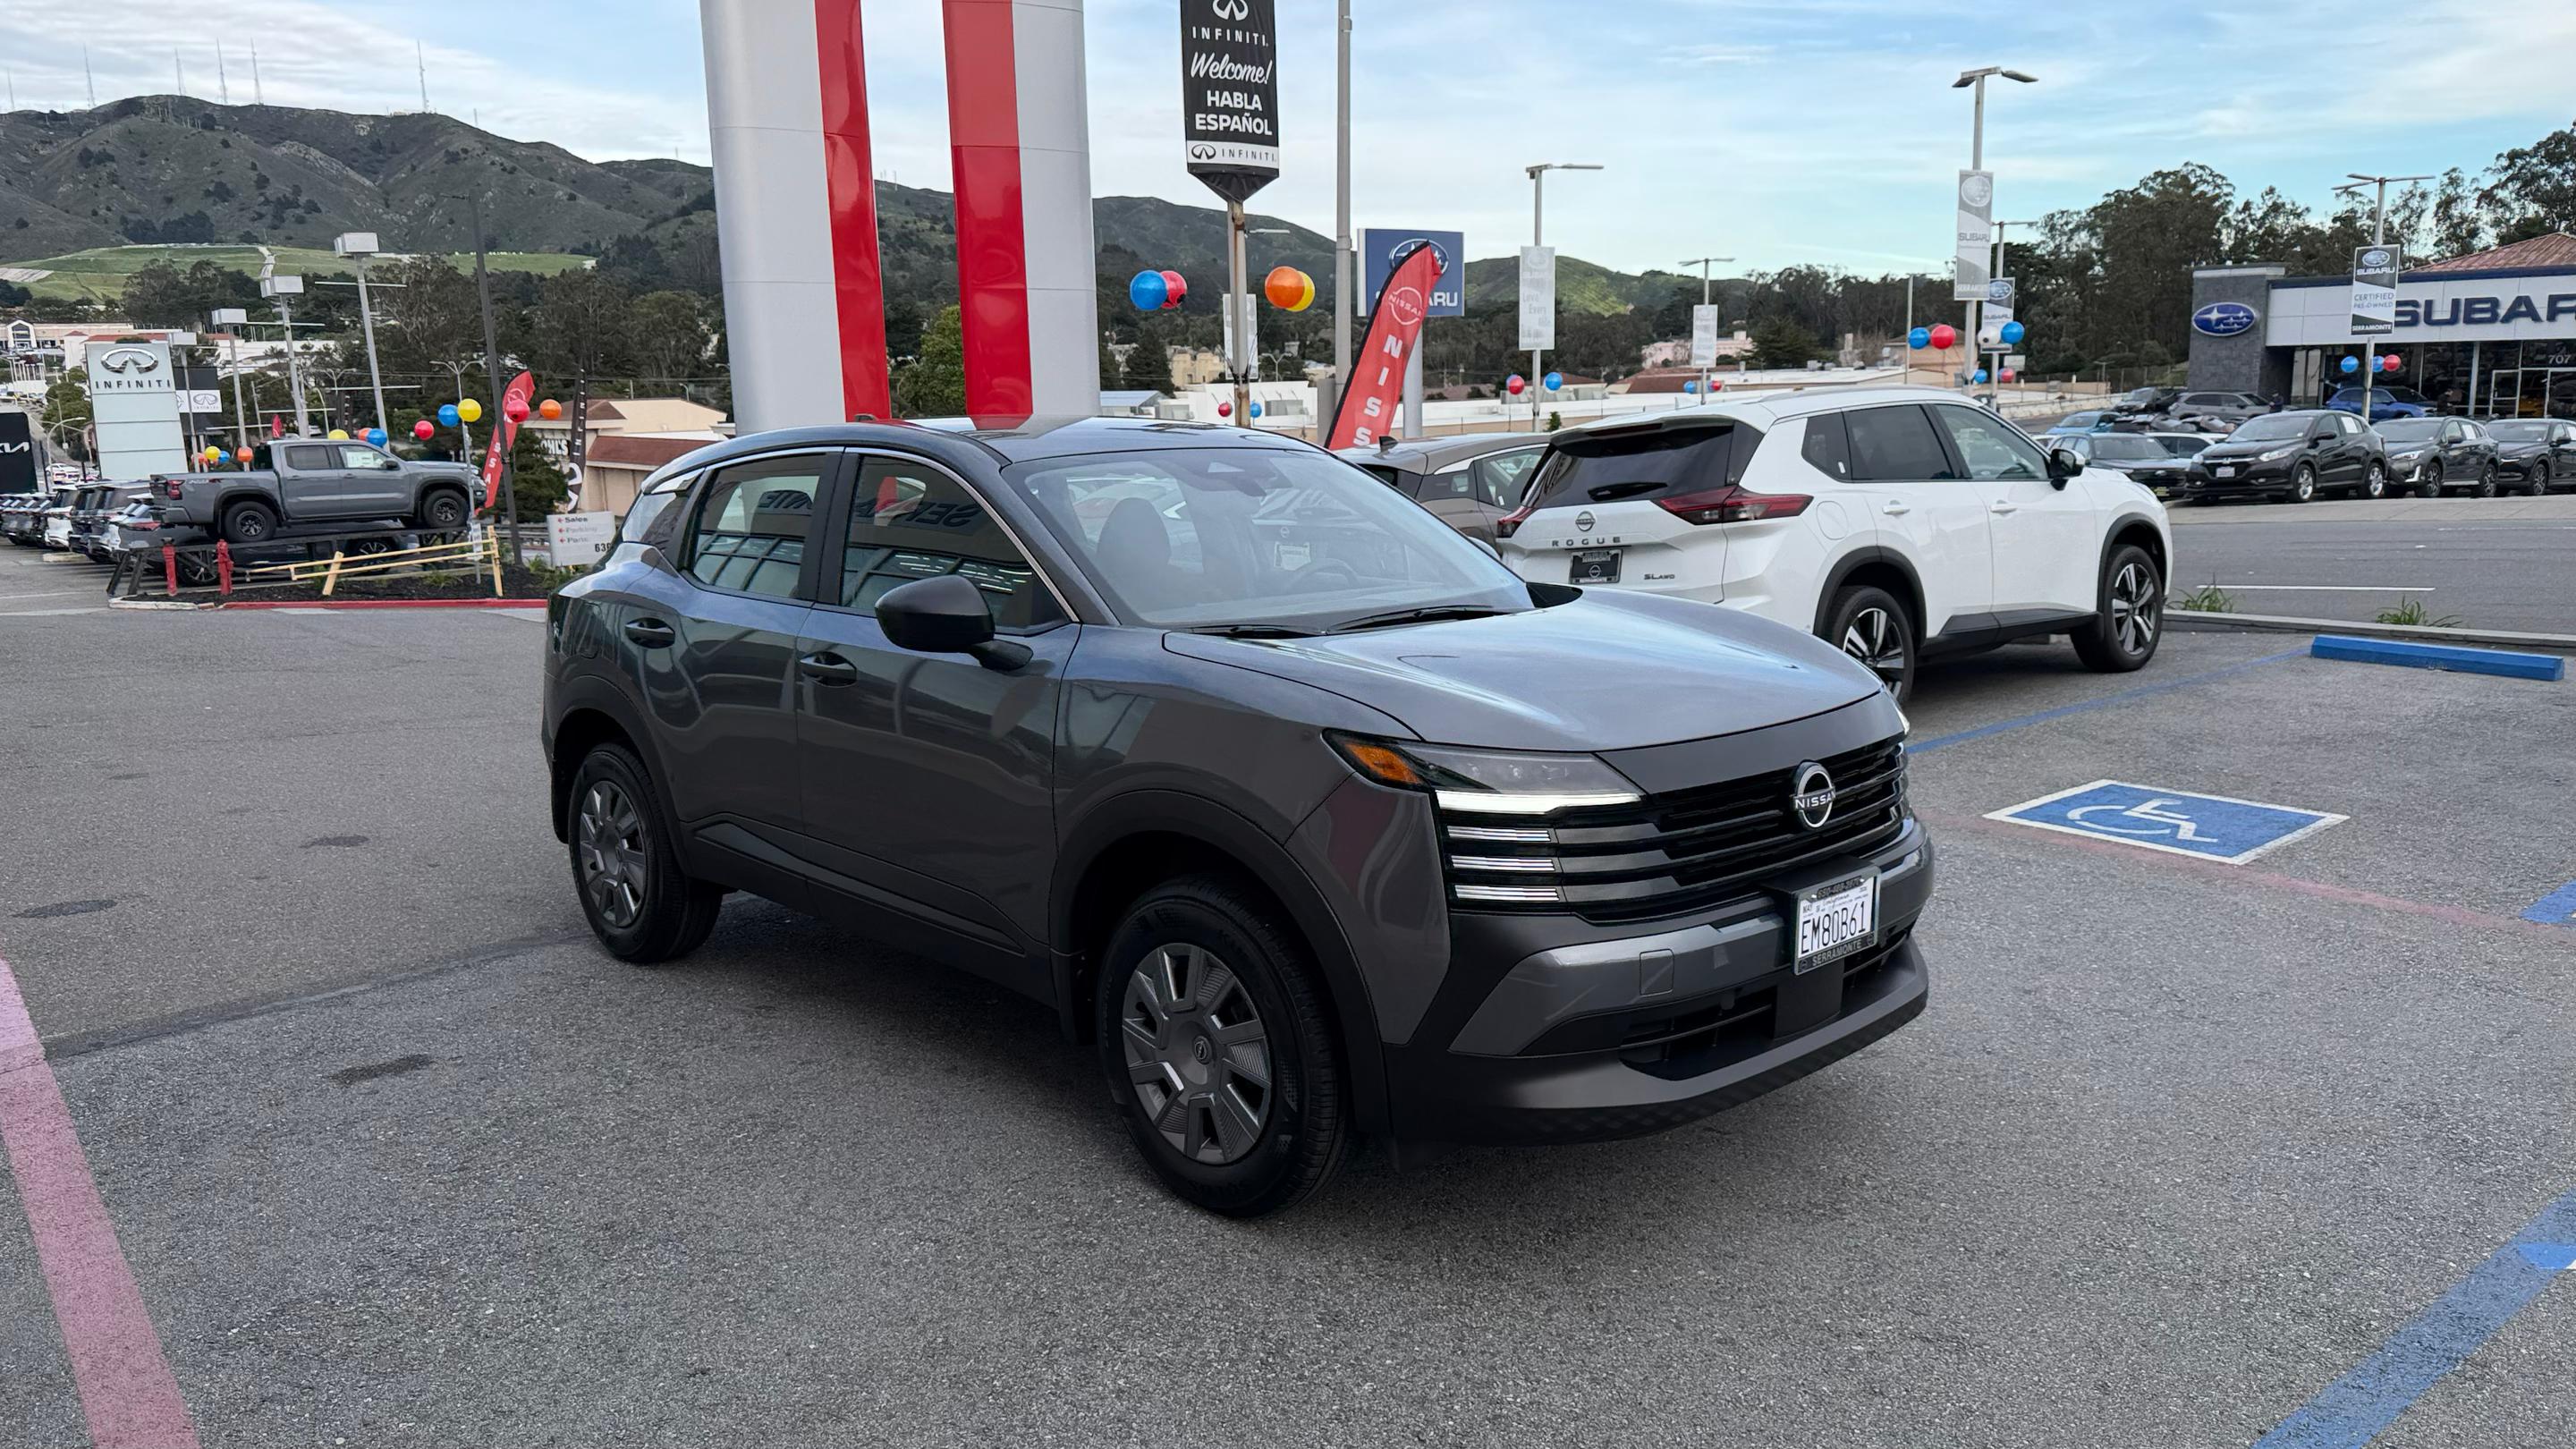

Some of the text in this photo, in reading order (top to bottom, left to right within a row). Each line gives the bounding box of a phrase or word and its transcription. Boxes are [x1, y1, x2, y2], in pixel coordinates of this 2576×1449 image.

[1191, 51, 1273, 85] Welcome!
[1207, 89, 1263, 112] HABLA
[1195, 113, 1273, 136] ESPAÑOL
[2356, 267, 2395, 275] SUBARU
[2353, 292, 2394, 301] CERTIFIED
[2548, 354, 2572, 364] 707
[95, 379, 172, 389] INFINITI
[1552, 537, 1621, 547] ROGUE
[1801, 901, 1866, 954] EM80B61
[1812, 939, 1862, 966] SERRAMONTE
